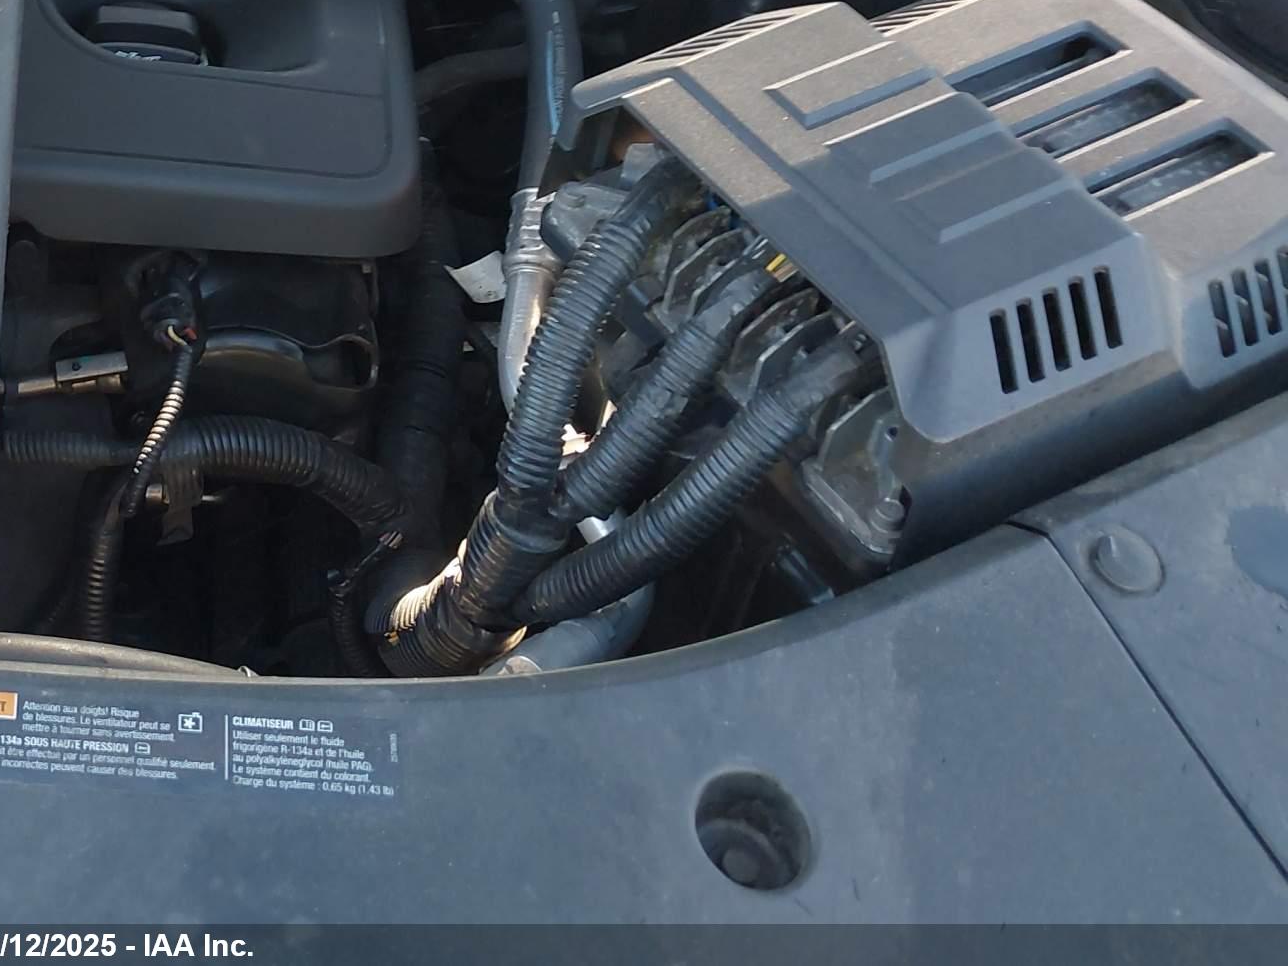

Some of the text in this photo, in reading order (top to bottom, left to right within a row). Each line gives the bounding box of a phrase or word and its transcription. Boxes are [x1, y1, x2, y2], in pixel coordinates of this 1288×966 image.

[22, 700, 140, 719] Attention aux doigts! Risque
[22, 711, 34, 721] de
[80, 716, 90, 726] Le
[92, 717, 137, 728] ventilateur
[139, 720, 158, 731] peut
[160, 722, 170, 731] se
[232, 716, 294, 730] CLIMATISEUR
[22, 724, 50, 733] mettre
[52, 724, 58, 733] à
[60, 726, 90, 736] tourner
[92, 728, 112, 737] sans
[232, 730, 344, 747] Utiliser seulement le fluide
[24, 736, 48, 748] SOUS
[50, 738, 80, 750] HAUTE
[83, 741, 129, 754] PRESSION
[280, 745, 313, 756] R-134a
[315, 748, 324, 756] et
[325, 748, 338, 758] de
[339, 749, 365, 760] l'huile
[7, 745, 24, 756] être
[62, 752, 77, 762] par
[79, 753, 90, 762] un
[92, 754, 134, 765] personnel
[232, 754, 244, 763] au
[326, 760, 350, 770] (huile
[352, 761, 374, 772] PAG).
[1, 758, 48, 771] incorrectes
[50, 762, 85, 773] peuvent
[86, 764, 116, 775] causer
[118, 766, 134, 776] des
[232, 764, 244, 774] Le
[284, 768, 318, 779] contient
[320, 770, 332, 780] du
[232, 776, 262, 788] Charge
[266, 778, 277, 787] du
[322, 782, 343, 792] 0.65
[344, 784, 356, 794] kg
[358, 784, 382, 795] (1.43
[383, 785, 394, 796] lb)
